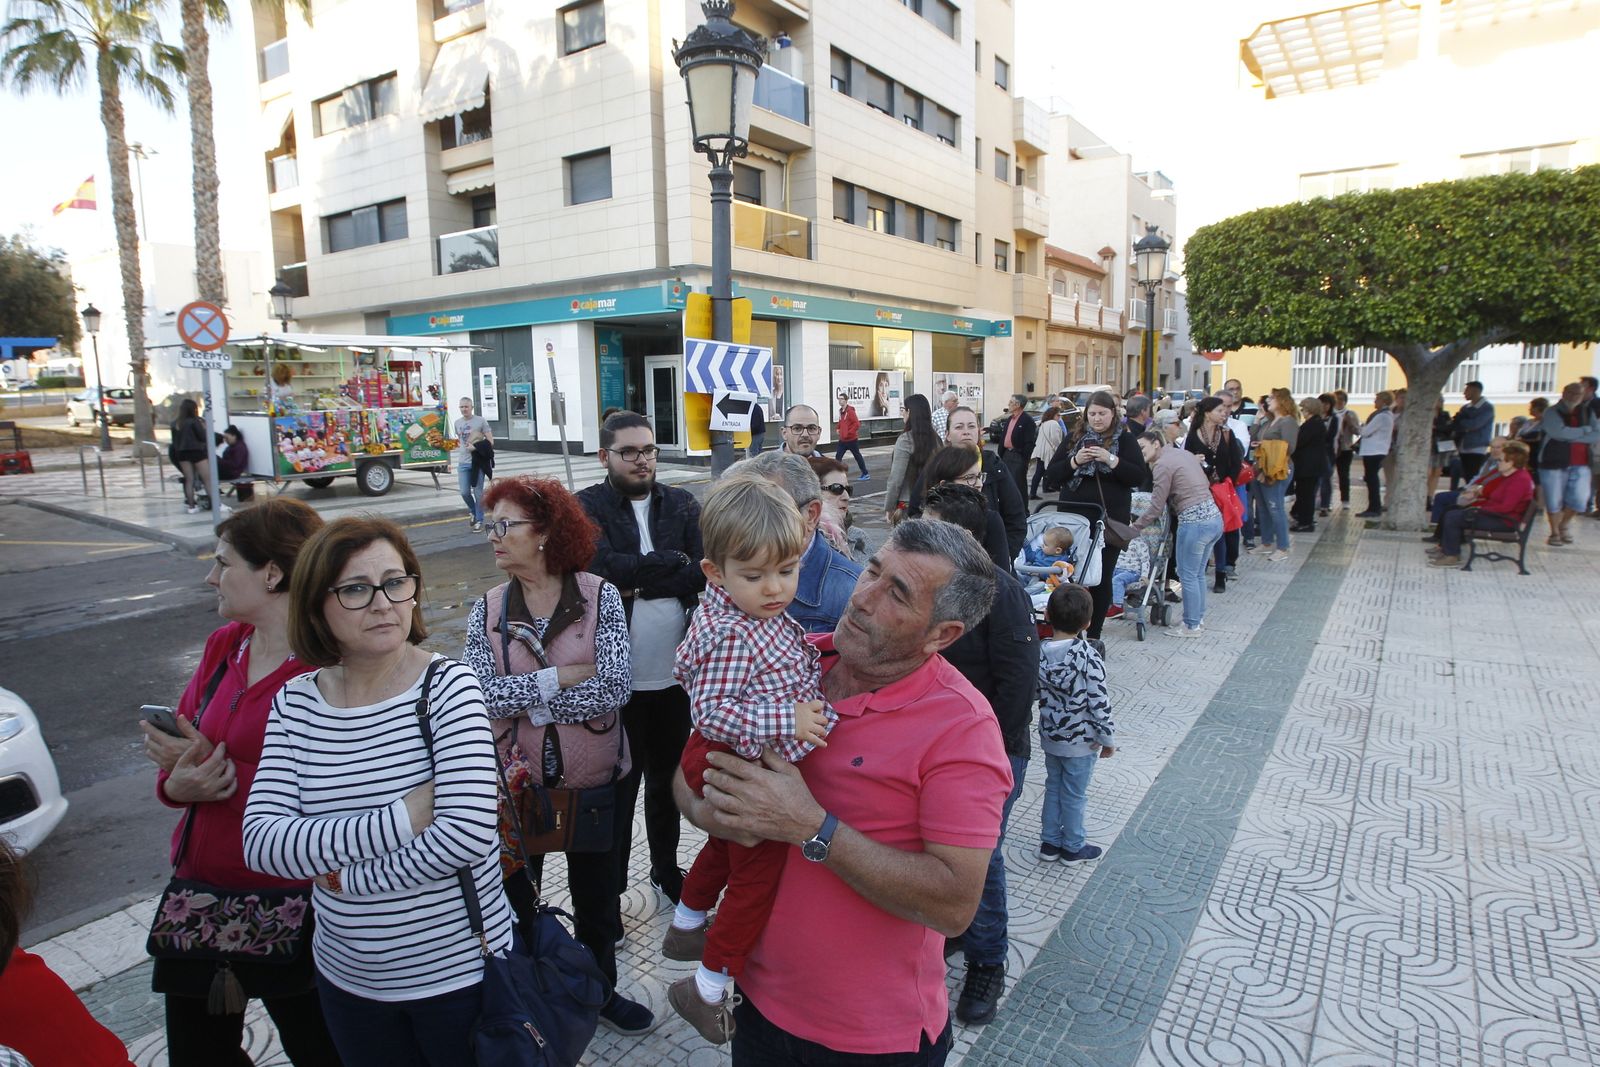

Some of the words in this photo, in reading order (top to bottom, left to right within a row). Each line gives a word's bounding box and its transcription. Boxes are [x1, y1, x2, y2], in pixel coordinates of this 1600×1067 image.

[580, 298, 617, 312] cajamar
[779, 296, 807, 310] cajamar
[437, 313, 465, 327] cajamar
[181, 351, 231, 361] EXCEPTO
[191, 360, 222, 369] TAXIS
